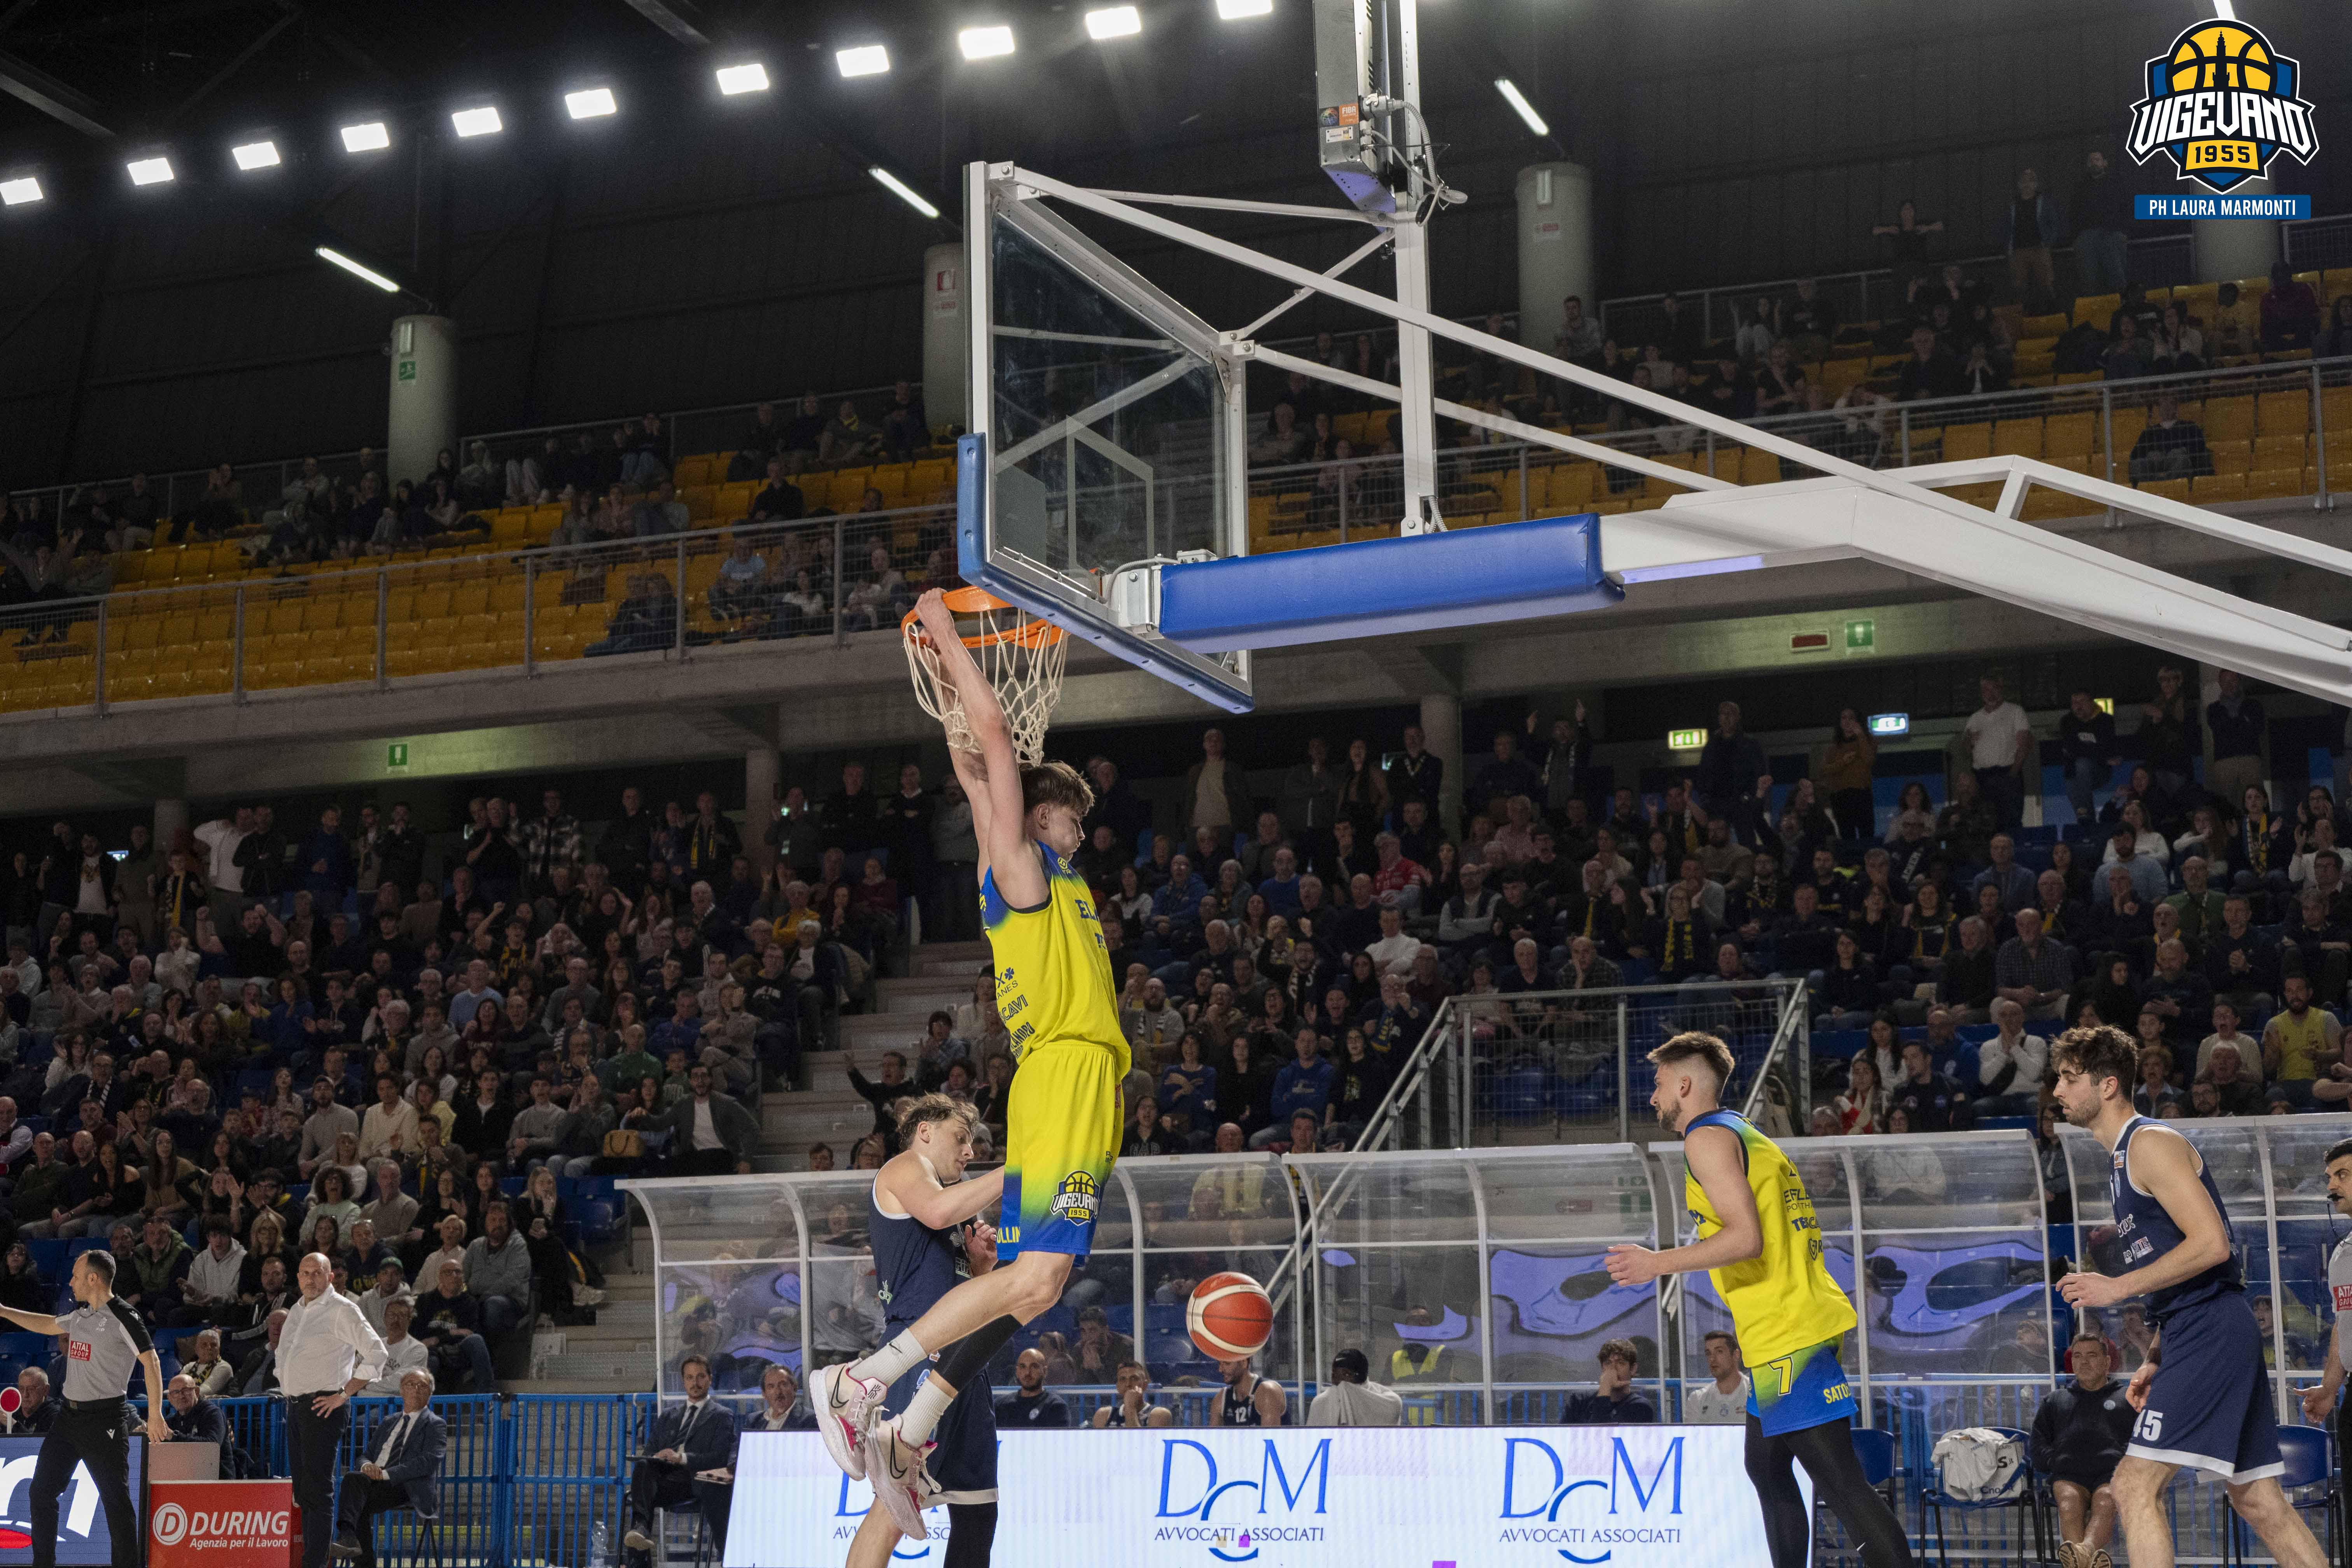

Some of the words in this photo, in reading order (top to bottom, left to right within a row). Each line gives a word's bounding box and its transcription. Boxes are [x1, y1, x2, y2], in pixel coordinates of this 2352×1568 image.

[1342, 106, 1356, 114] FIBA
[996, 980, 1018, 1000] ANES
[1052, 1192, 1099, 1216] VIGEVANO
[1071, 1209, 1087, 1217] 1955
[71, 1349, 88, 1358] GROUP
[72, 1341, 89, 1352] ATTAL
[1767, 1355, 1794, 1396] 7
[1235, 1407, 1247, 1423] 12
[2133, 1409, 2163, 1441] 45
[190, 1511, 289, 1536] DURING
[1155, 1527, 1235, 1541] AVVOCATI
[1239, 1527, 1324, 1542] ASSOCIATI
[1499, 1528, 1585, 1543] AVVOCATI
[1591, 1528, 1680, 1543] ASSOCIATI
[189, 1537, 227, 1550] Agenzia
[229, 1540, 246, 1549] per
[247, 1537, 254, 1547] il
[256, 1538, 289, 1547] Lavoro
